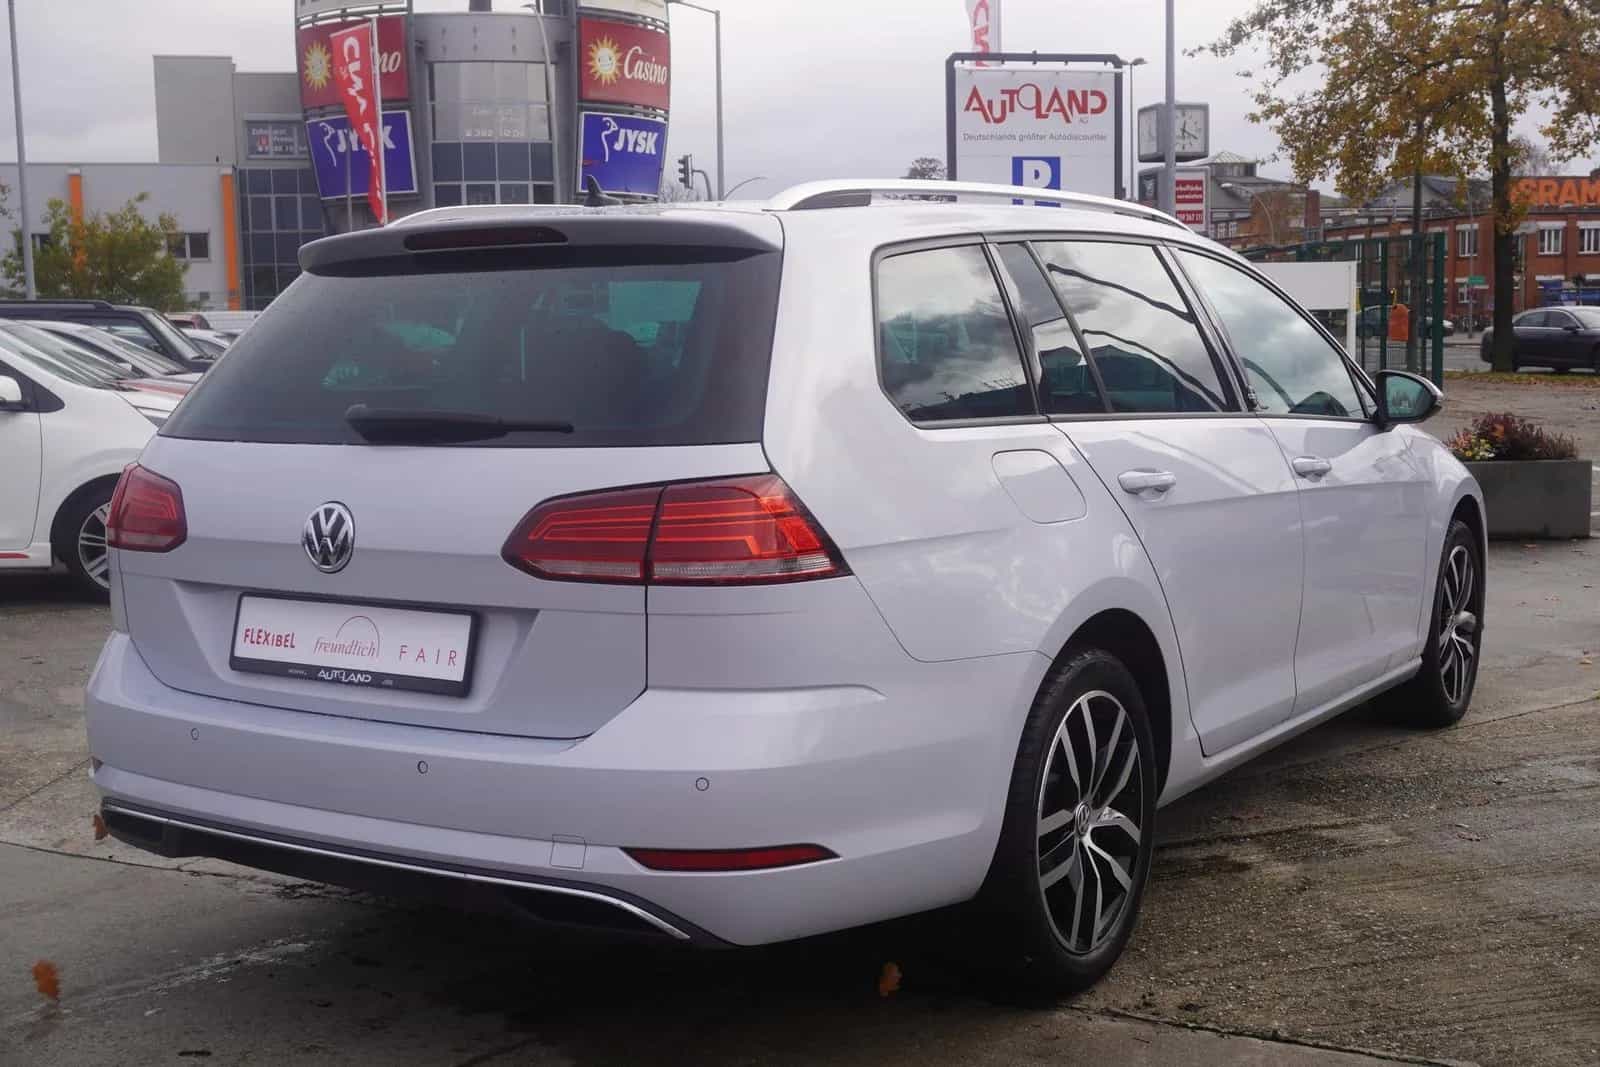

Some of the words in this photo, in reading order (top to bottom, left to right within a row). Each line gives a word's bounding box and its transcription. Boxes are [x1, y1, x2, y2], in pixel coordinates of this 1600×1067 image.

[624, 46, 668, 85] Casino
[963, 83, 1109, 124] AUTOLAND
[614, 128, 658, 155] JYSK
[962, 132, 1017, 143] Deutschlands
[1049, 132, 1107, 142] Autodiscounter
[243, 627, 296, 649] FLEXIBEL
[313, 636, 376, 658] freundlich
[317, 669, 373, 684] AUTOLAND
